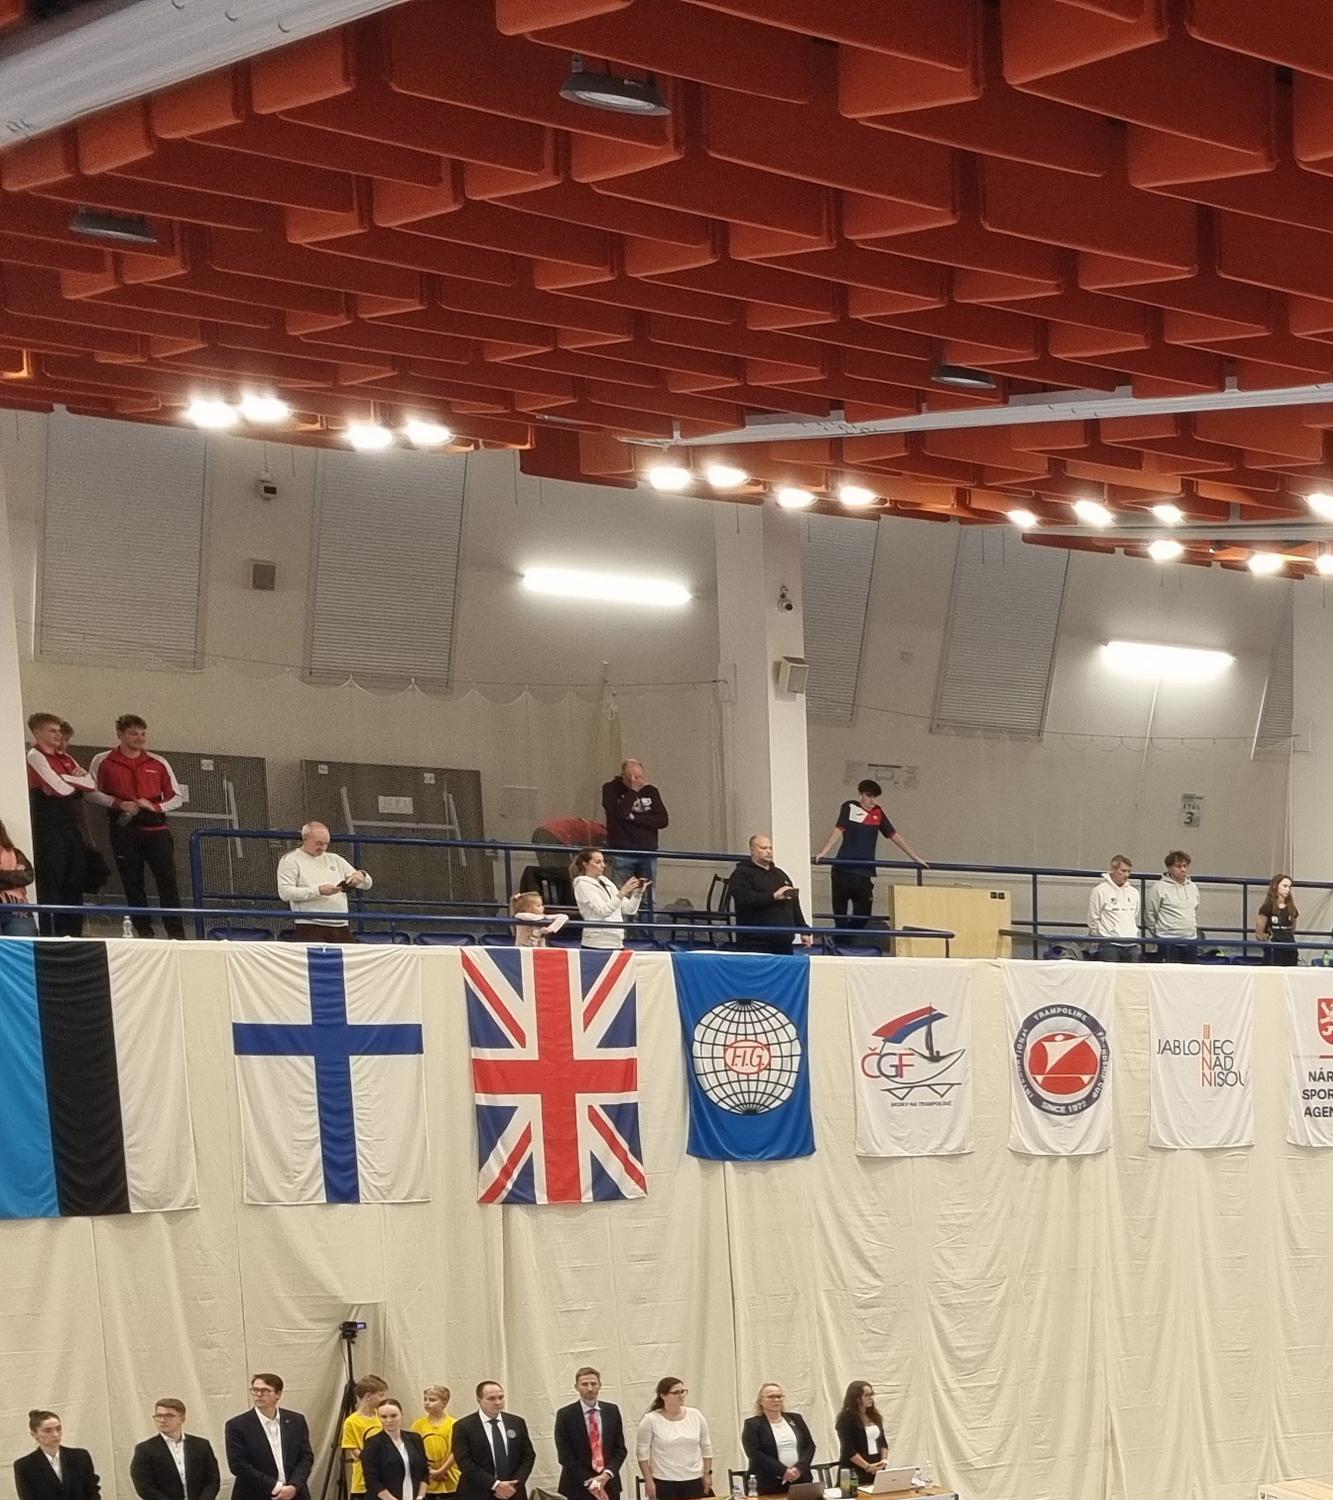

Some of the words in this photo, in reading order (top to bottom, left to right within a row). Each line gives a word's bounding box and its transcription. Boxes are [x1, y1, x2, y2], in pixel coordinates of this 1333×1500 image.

[1183, 811, 1194, 826] 3
[1032, 1007, 1088, 1021] TRAMPOLINE
[1157, 1038, 1234, 1056] JABLONEC
[860, 1046, 915, 1079] ČGF
[1202, 1055, 1234, 1071] NAD
[1040, 1101, 1067, 1113] SINCE
